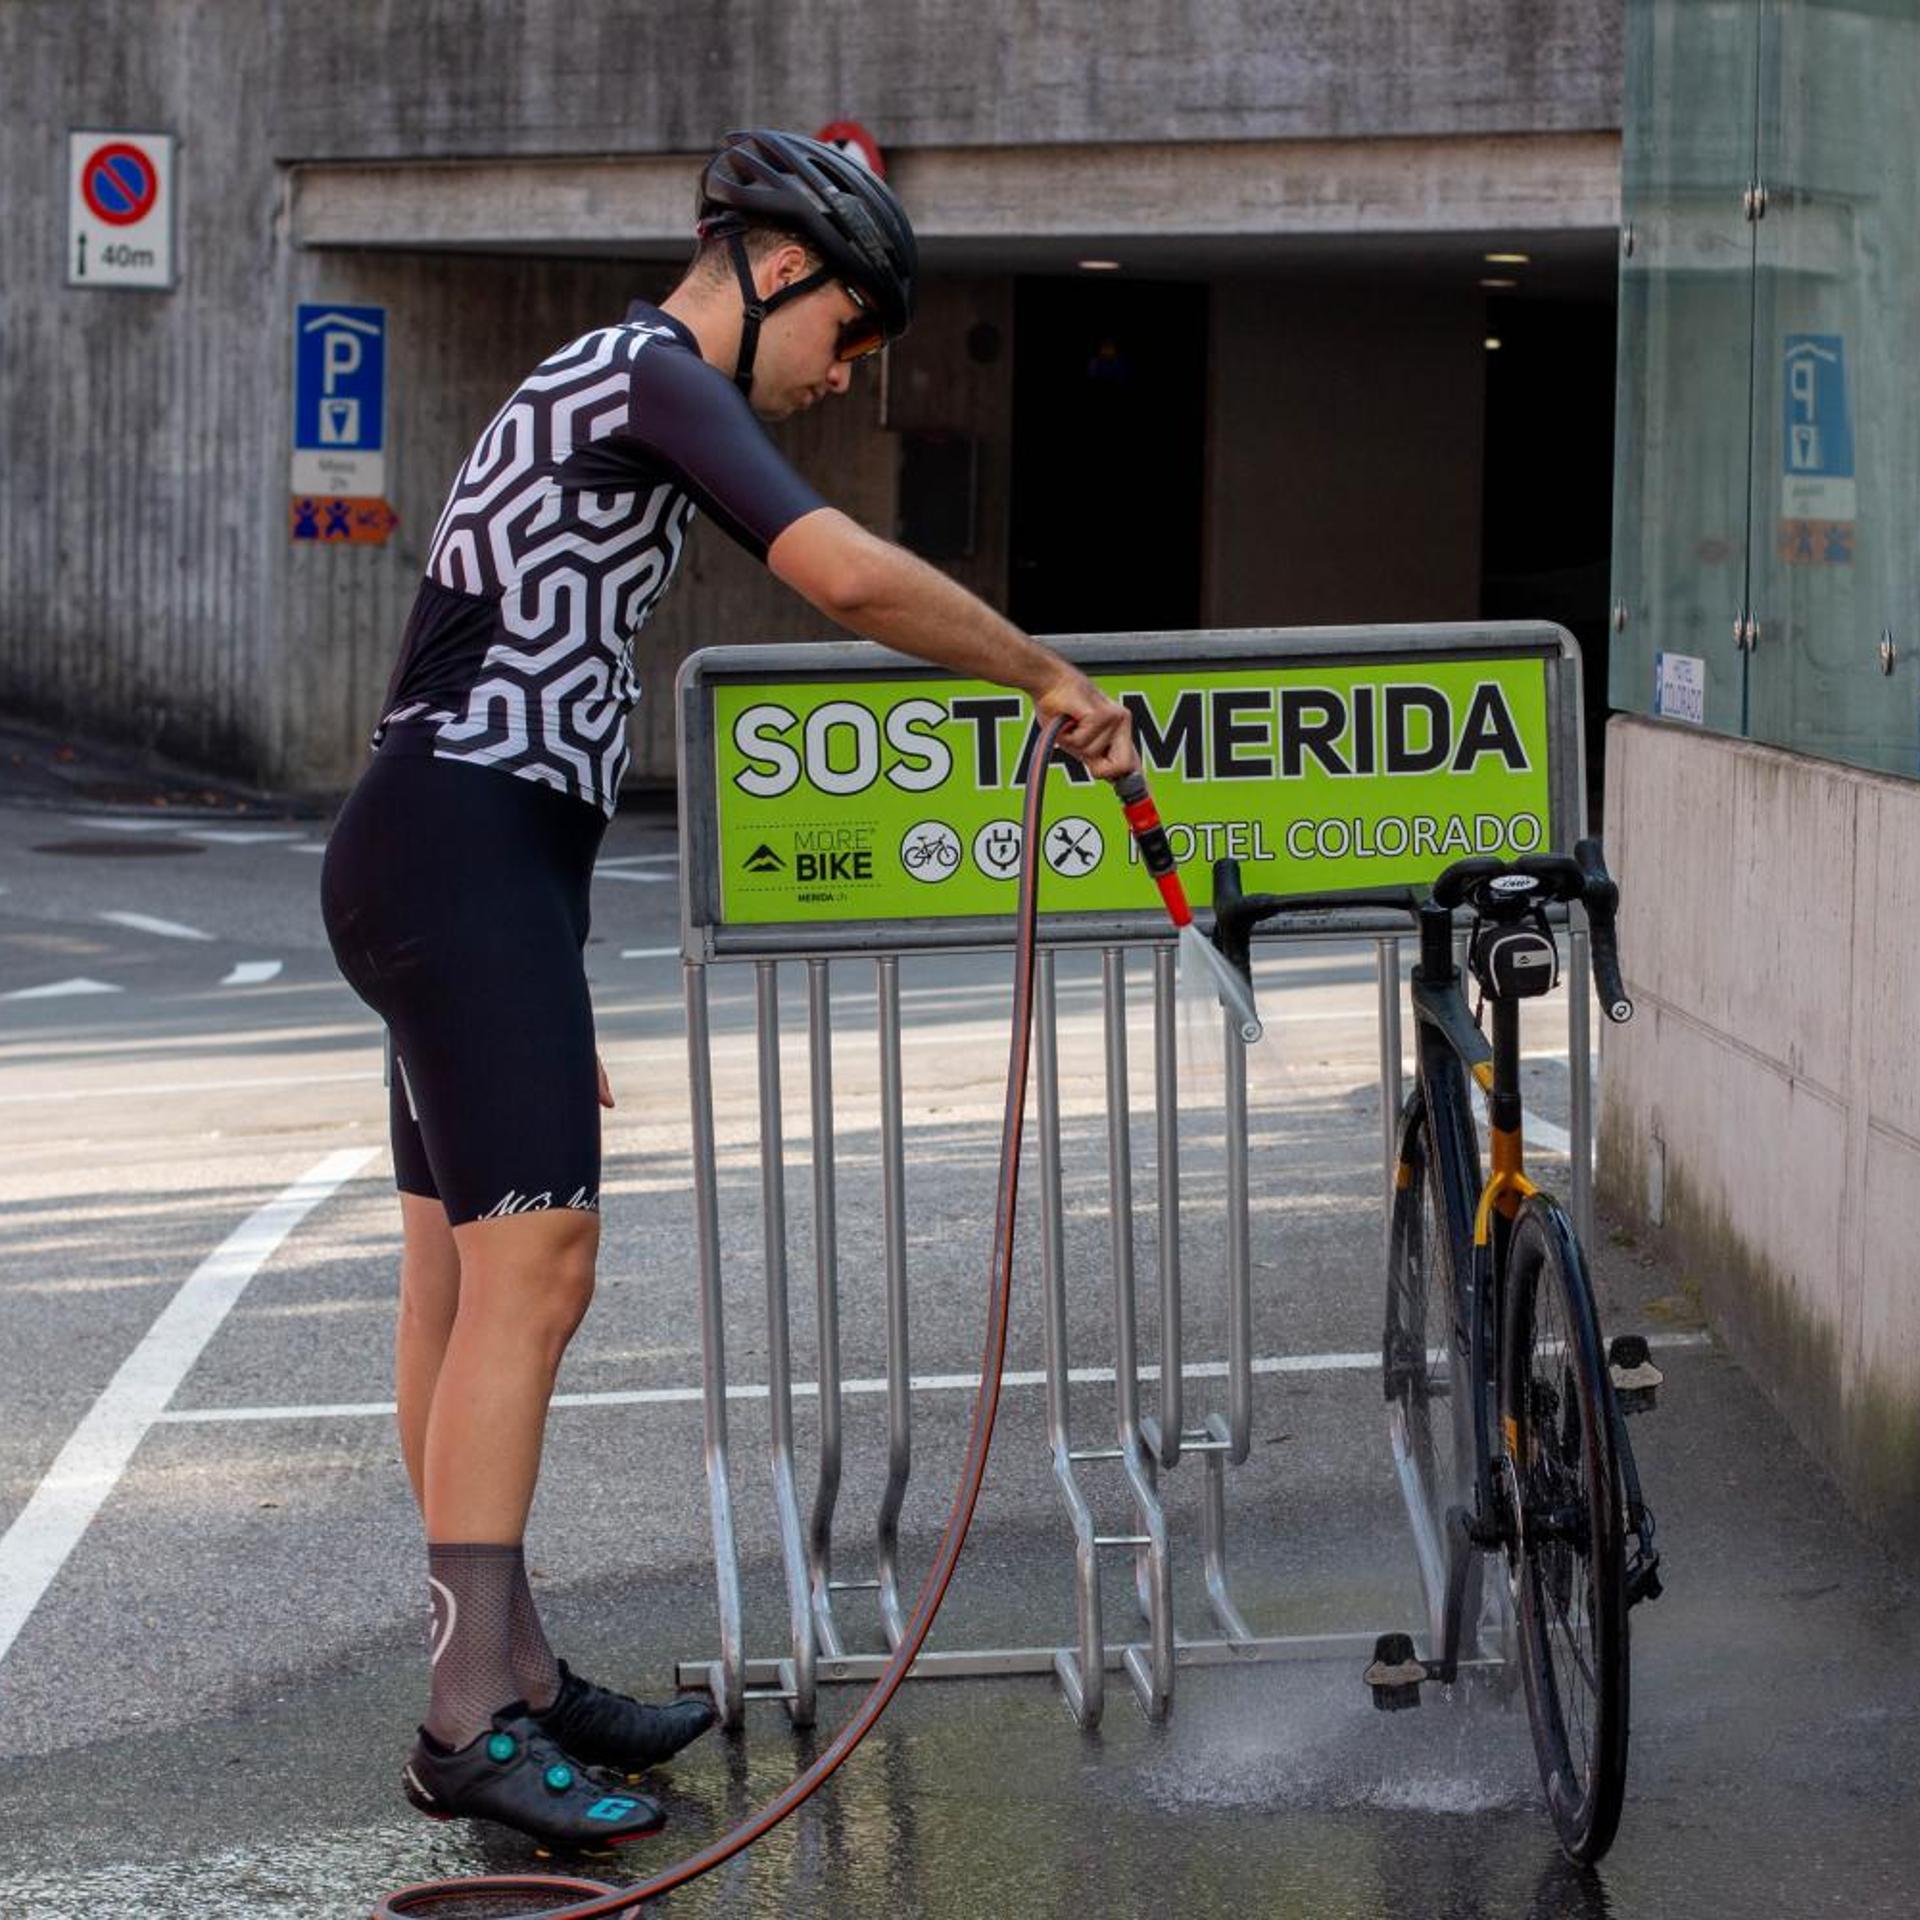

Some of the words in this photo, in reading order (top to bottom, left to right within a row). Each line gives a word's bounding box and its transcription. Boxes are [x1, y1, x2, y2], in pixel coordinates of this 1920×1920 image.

[101, 245, 155, 268] 40m
[323, 331, 361, 394] P
[1119, 680, 1534, 783] MERIDA
[1286, 812, 1542, 859] COLORADO
[796, 851, 873, 882] BIKE
